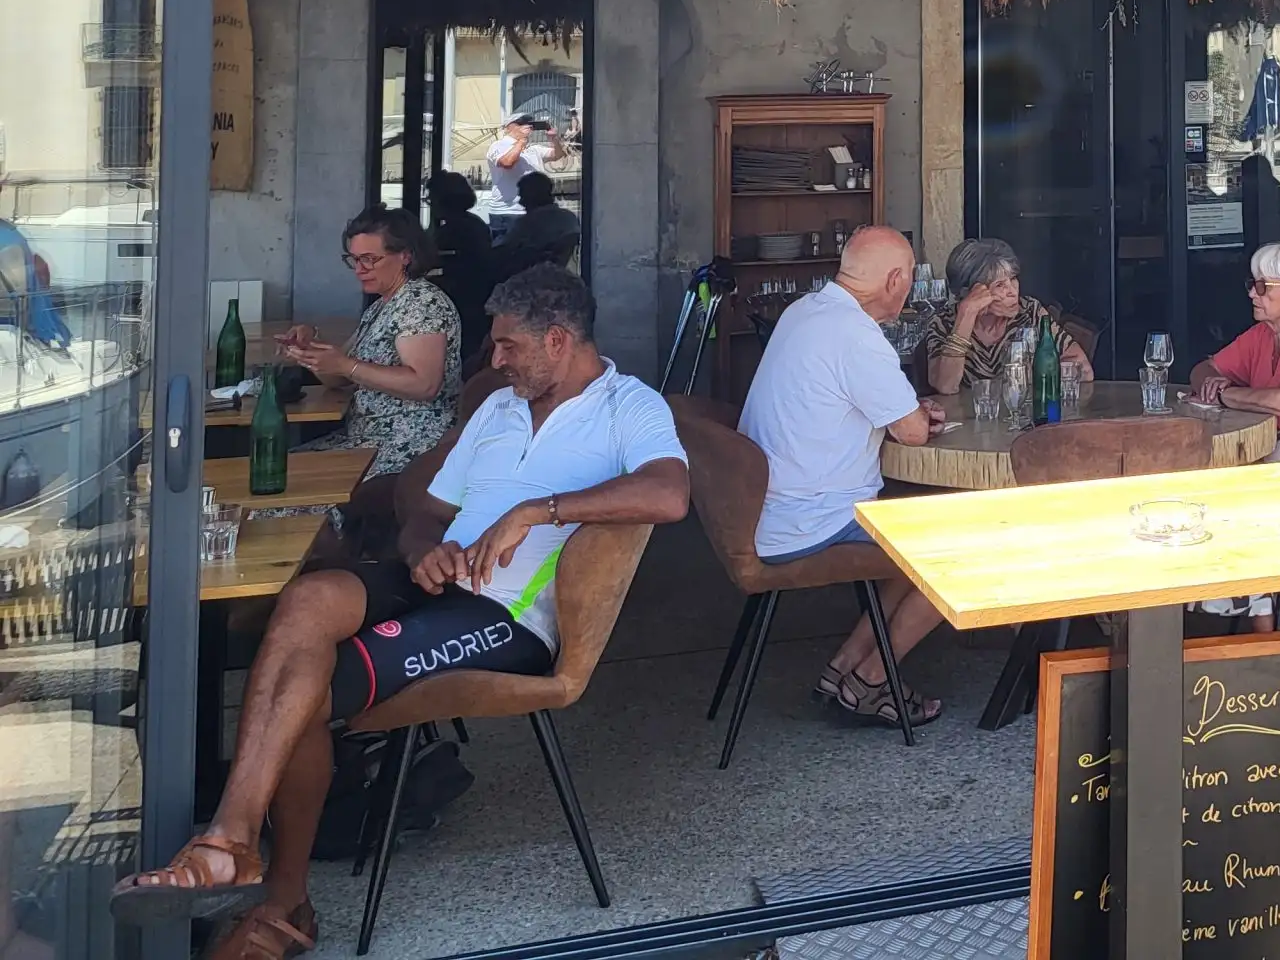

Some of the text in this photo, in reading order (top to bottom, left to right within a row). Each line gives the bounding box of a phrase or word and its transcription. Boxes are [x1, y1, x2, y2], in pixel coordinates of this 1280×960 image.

[404, 621, 513, 677] SUNDRIED
[1082, 773, 1111, 802] Tar
[1182, 765, 1229, 790] itron
[1201, 803, 1222, 824] de
[1182, 853, 1280, 892] au Rhum
[1182, 920, 1216, 941] ème
